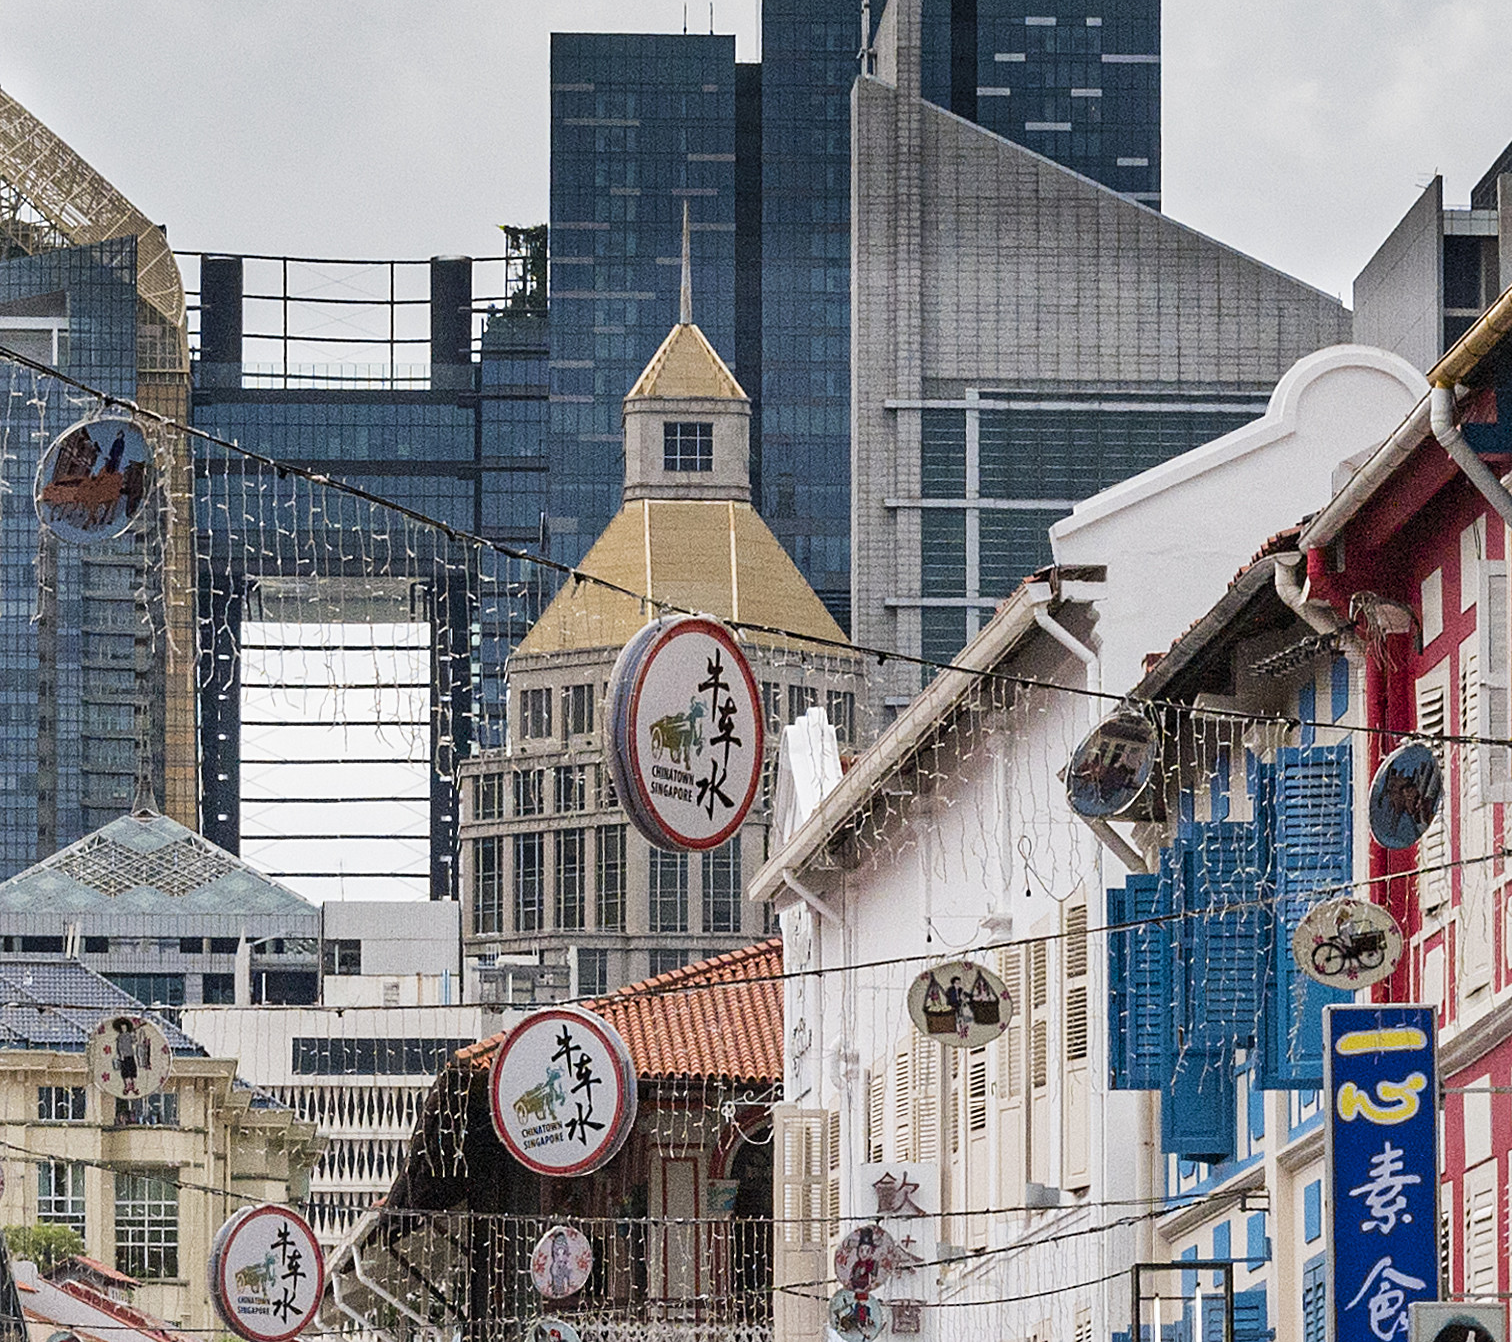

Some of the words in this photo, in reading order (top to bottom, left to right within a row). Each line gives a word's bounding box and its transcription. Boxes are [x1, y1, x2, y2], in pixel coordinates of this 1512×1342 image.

[696, 648, 743, 820] 牛车水
[651, 765, 694, 786] CHINATOWN
[650, 781, 693, 803] SINGAPORE
[551, 1024, 605, 1146] 牛车水
[521, 1121, 563, 1138] CHINATOWN
[523, 1132, 564, 1149] SINGAPORE
[271, 1222, 306, 1324] 牛车水
